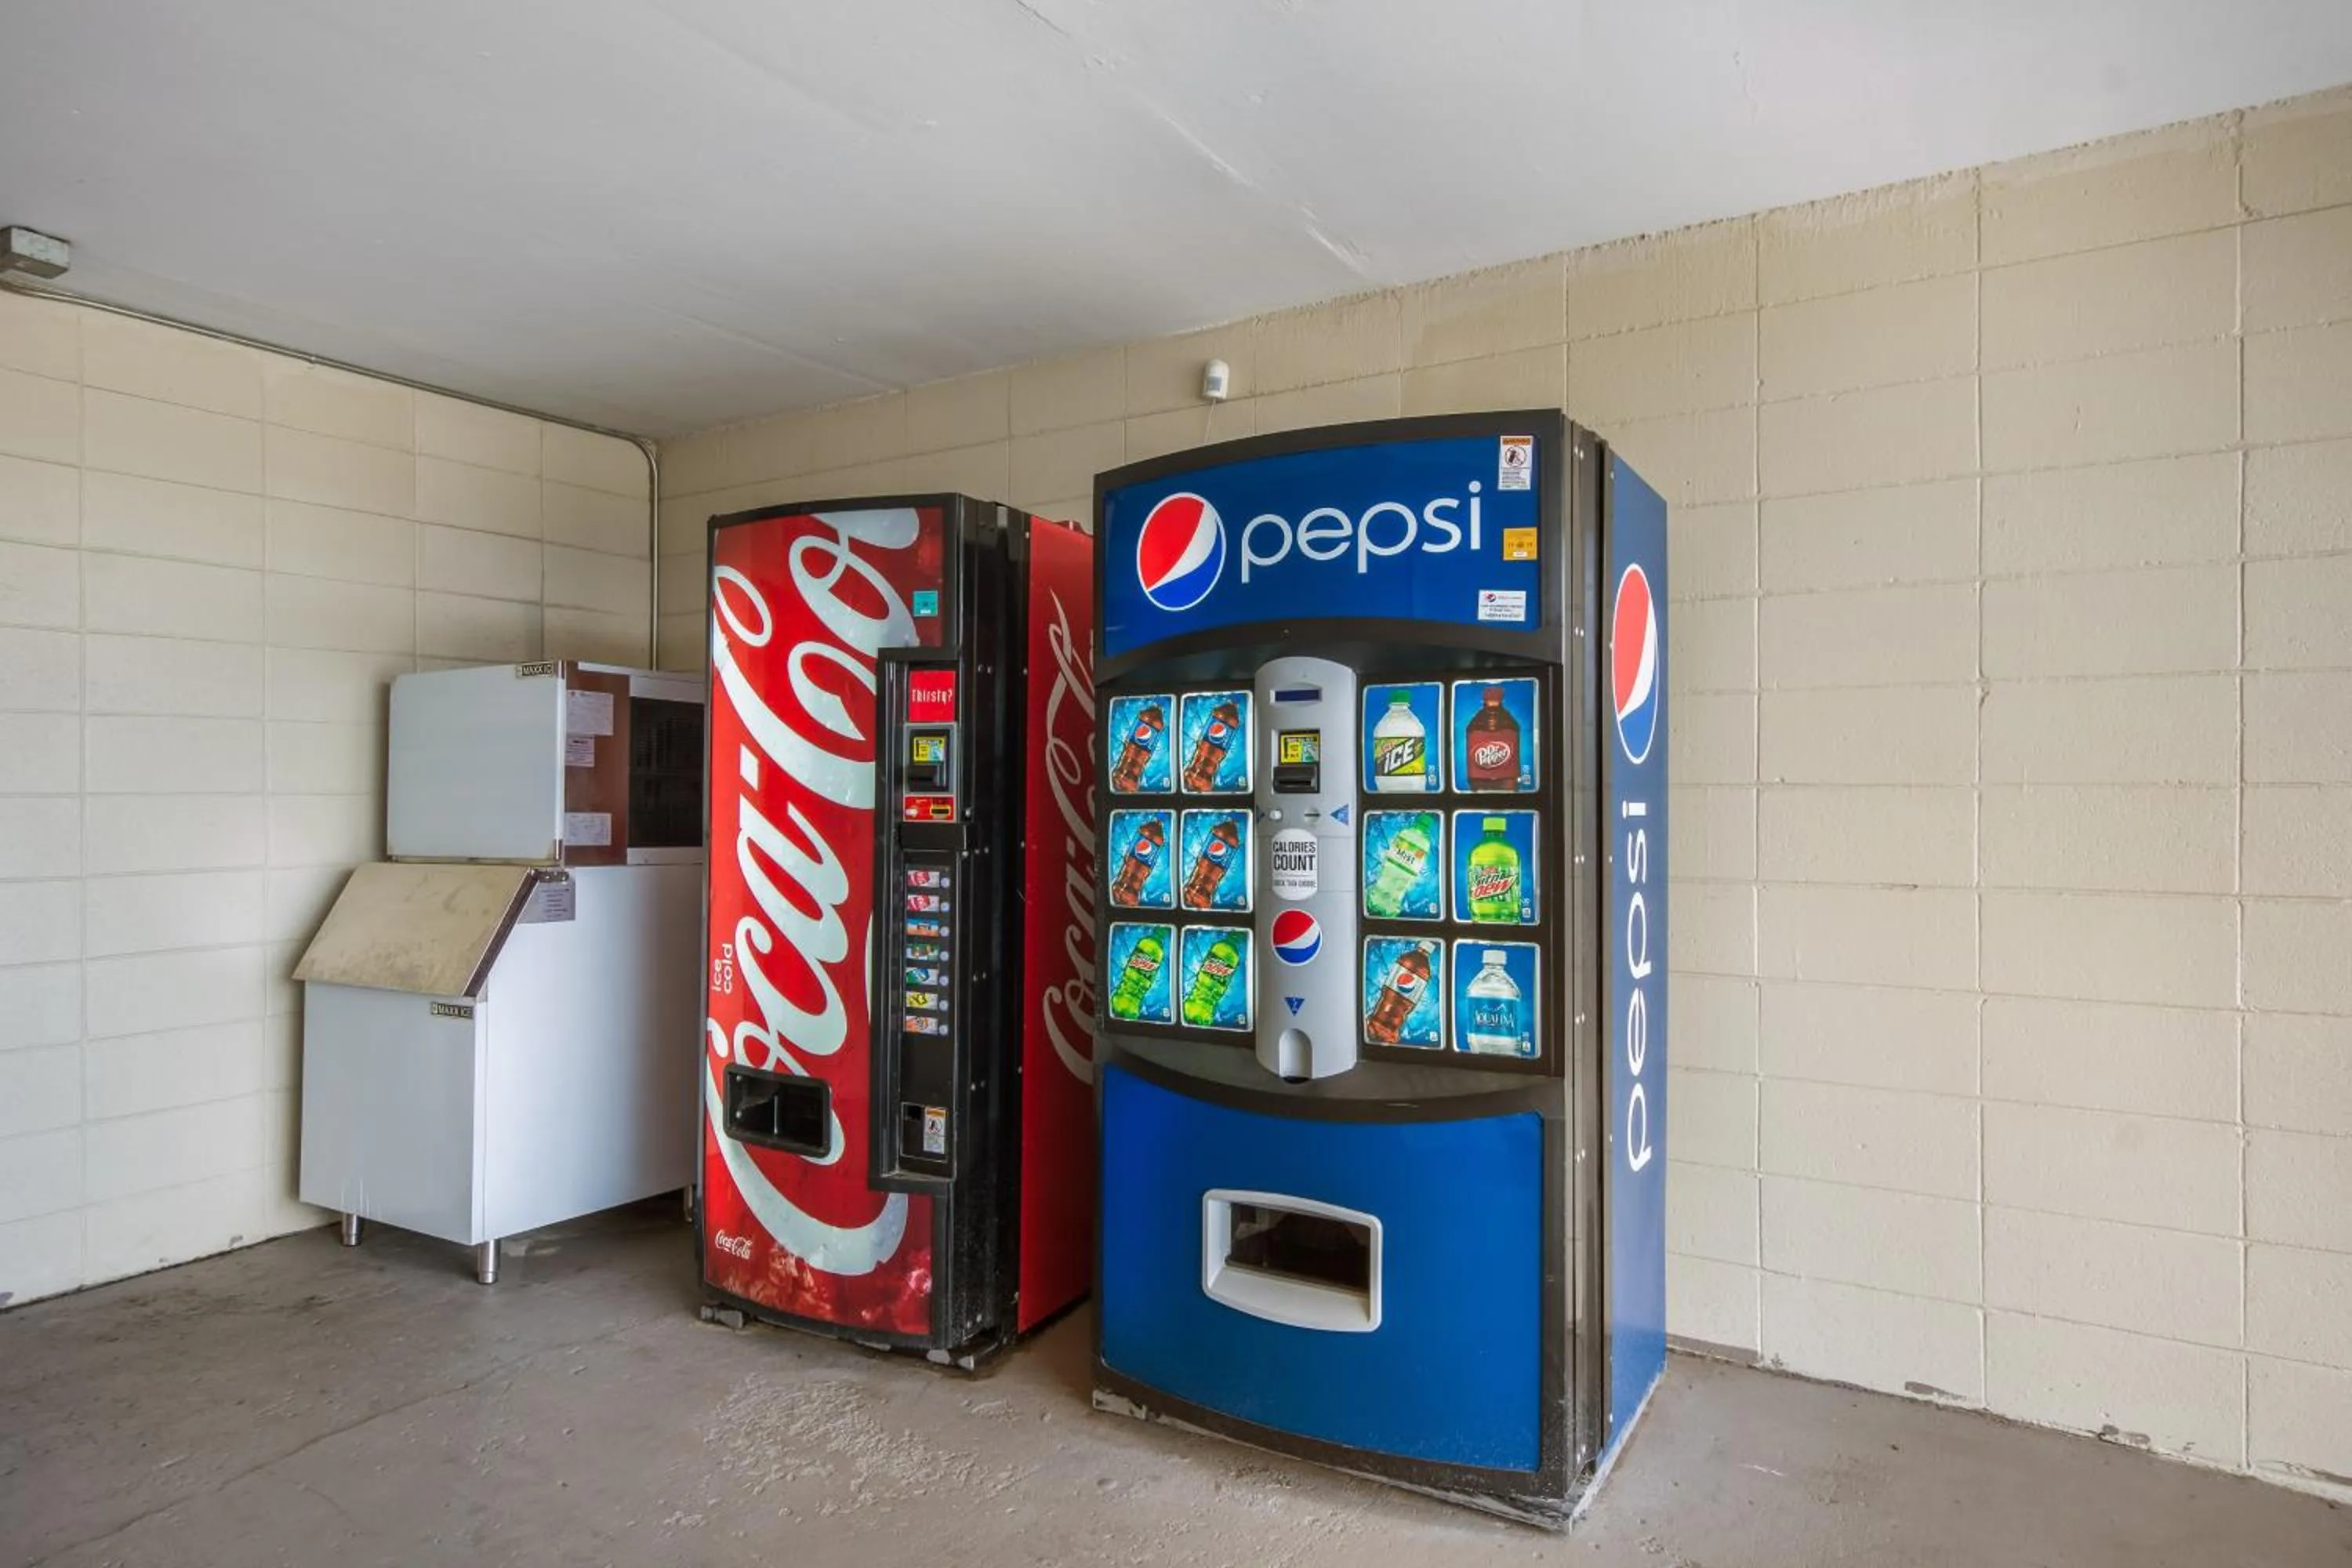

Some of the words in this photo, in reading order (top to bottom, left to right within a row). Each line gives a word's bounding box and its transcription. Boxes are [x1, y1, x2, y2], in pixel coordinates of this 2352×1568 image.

[1241, 480, 1483, 584] pepsi
[912, 688, 953, 706] Thirsty?
[1384, 738, 1415, 775] ICE
[1479, 747, 1508, 766] Pepper
[1487, 744, 1500, 754] Dr
[1272, 840, 1316, 854] CALORIES
[1273, 854, 1316, 871] COUNT
[721, 943, 733, 995] cold
[1622, 800, 1652, 1172] pepsi
